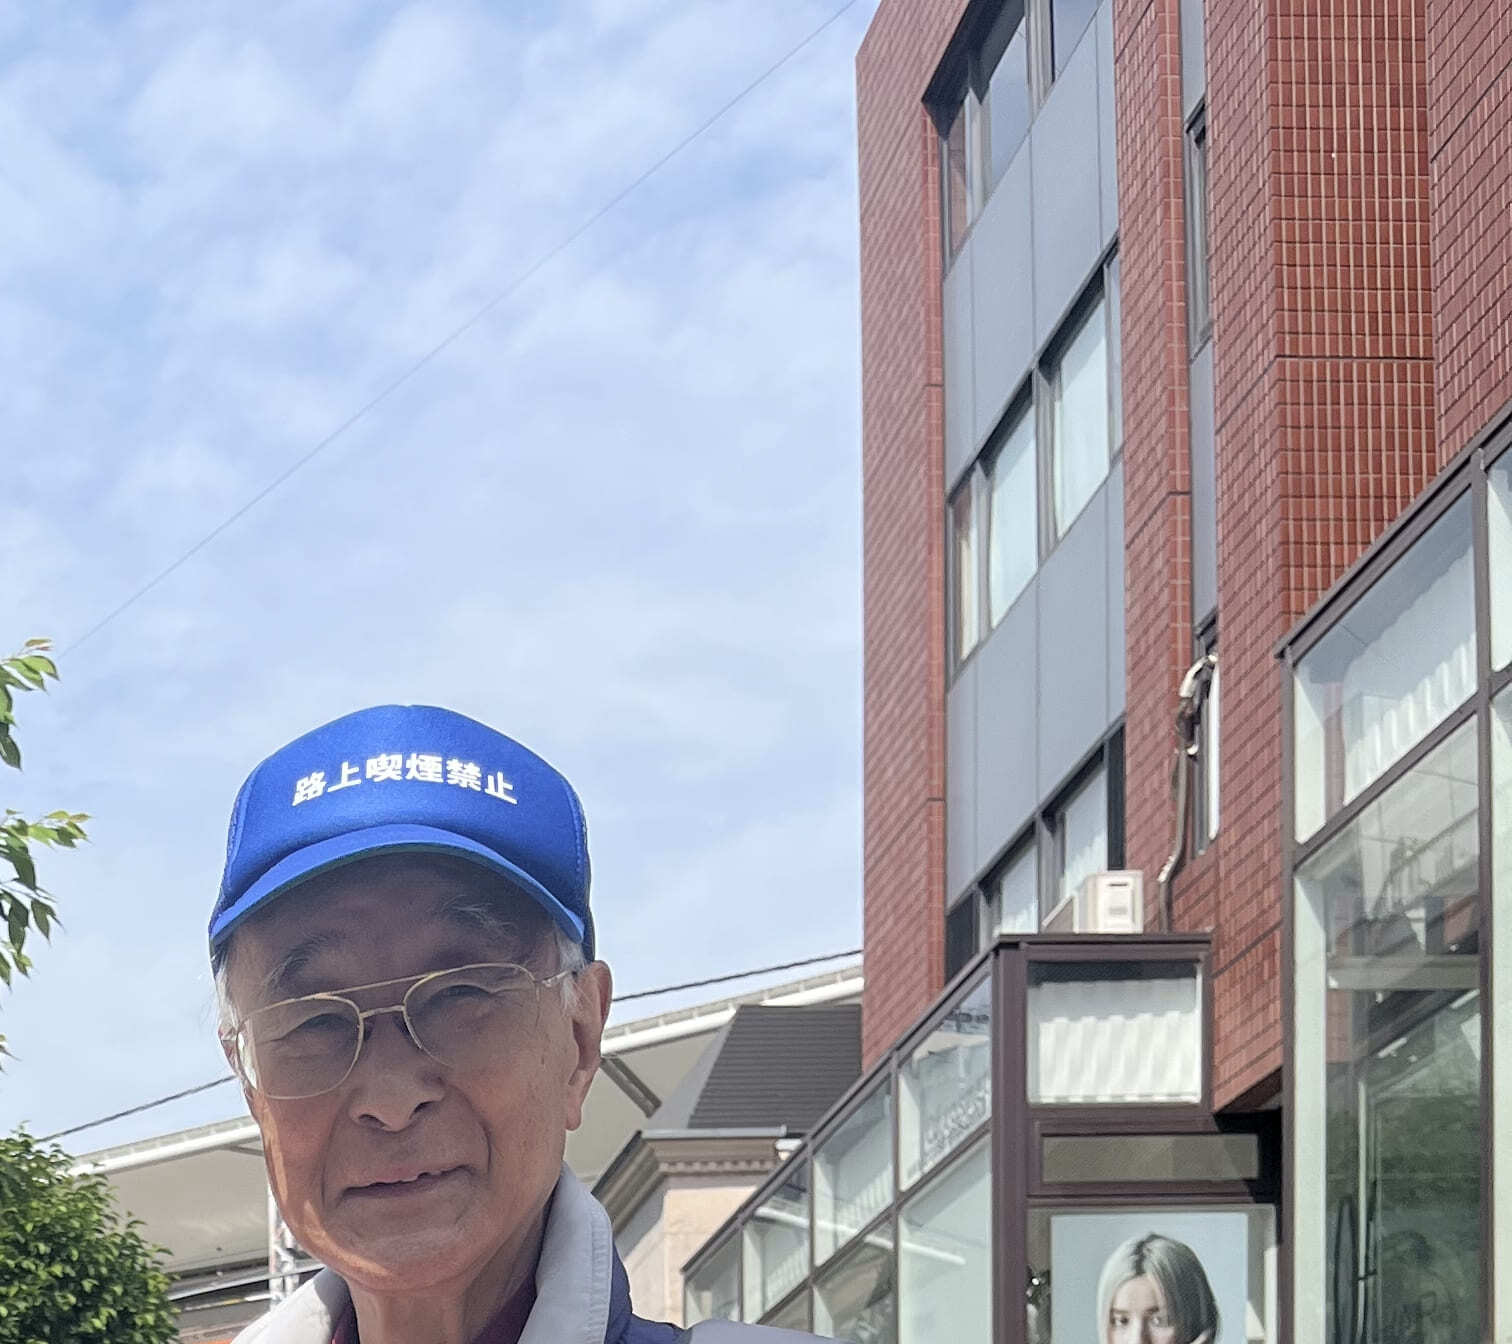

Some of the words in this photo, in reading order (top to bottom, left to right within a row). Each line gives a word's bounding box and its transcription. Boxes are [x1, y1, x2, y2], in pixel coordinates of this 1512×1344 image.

[291, 752, 518, 807] 路上喫煙禁止
